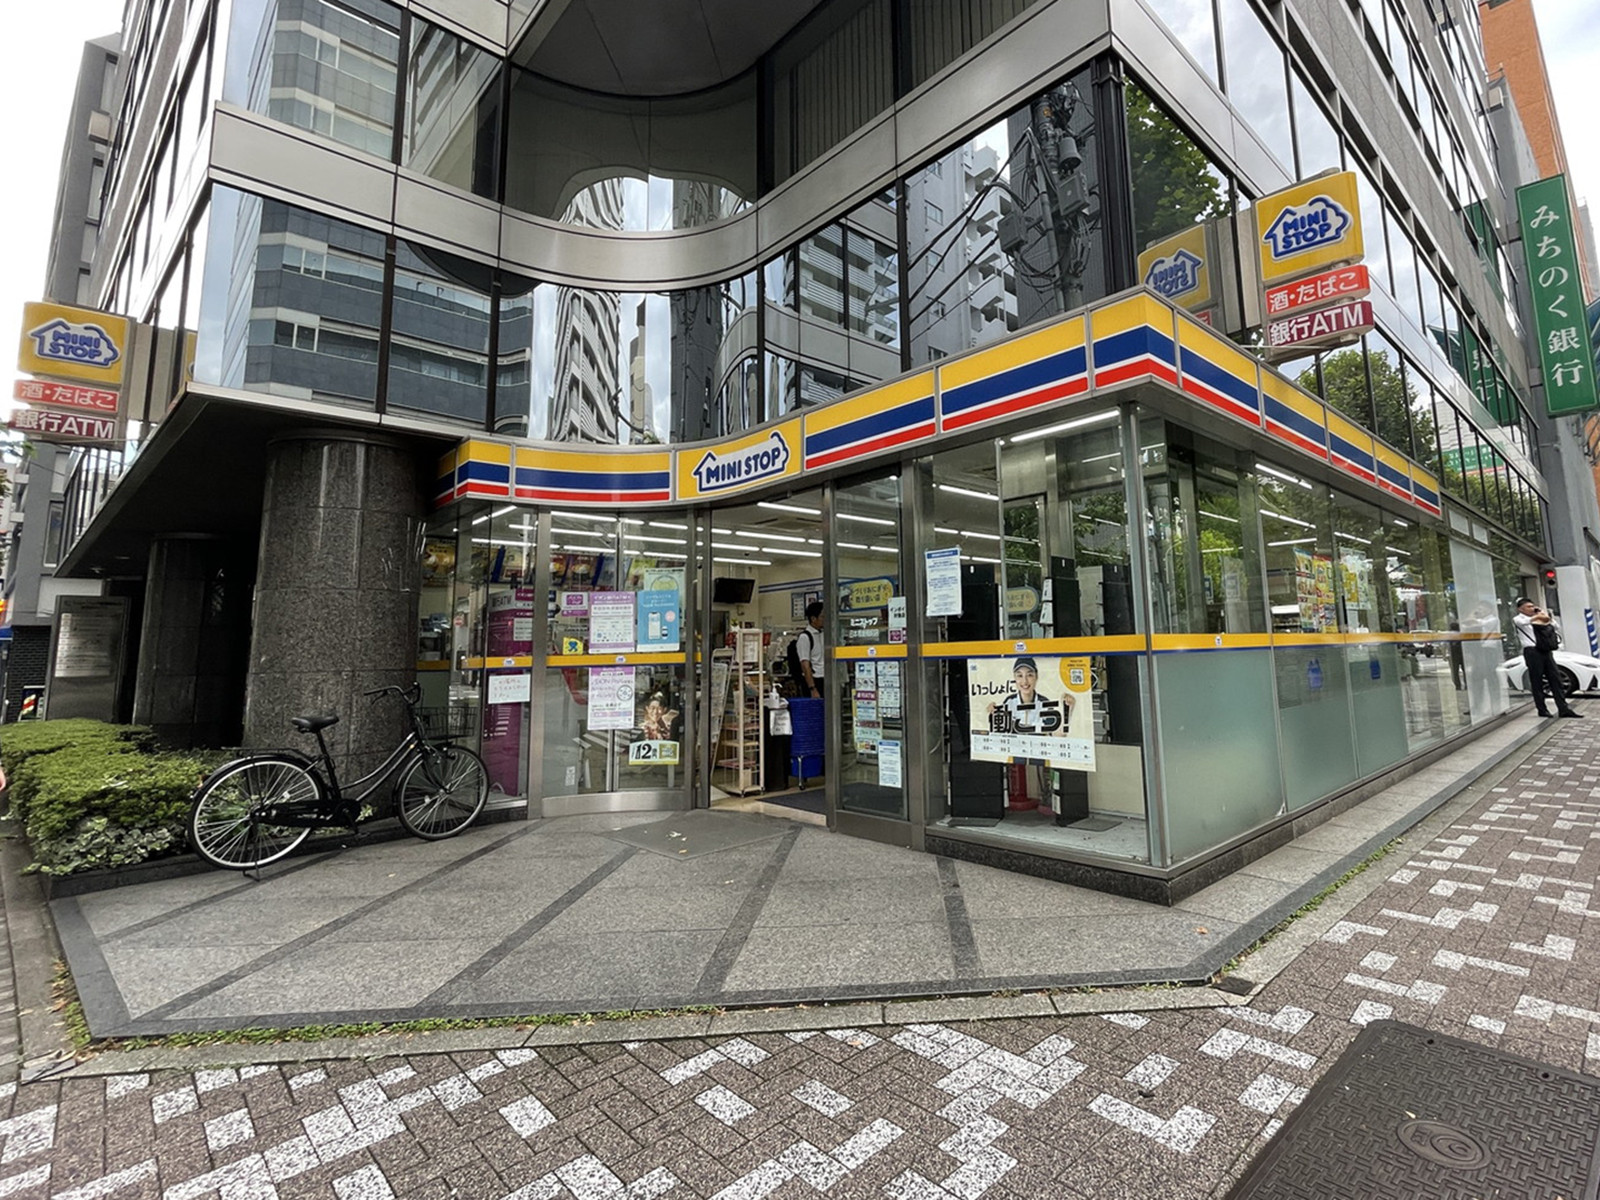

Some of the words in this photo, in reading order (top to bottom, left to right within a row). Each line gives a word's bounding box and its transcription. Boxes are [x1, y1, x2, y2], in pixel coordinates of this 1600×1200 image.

[1281, 222, 1332, 249] STOP
[1282, 208, 1328, 235] MINI
[1269, 272, 1359, 313] 酒・たばこ
[1530, 205, 1584, 387] みちのく銀行
[1270, 304, 1364, 346] 銀行ATM
[49, 342, 102, 359] STOP
[53, 330, 101, 349] MINI
[21, 383, 114, 409] 酒・たばこ
[15, 410, 114, 439] 銀行ATM
[706, 459, 742, 484] MINI
[744, 447, 781, 475] STOP
[971, 680, 1017, 696] いっしょに
[988, 700, 1070, 734] 働こう!
